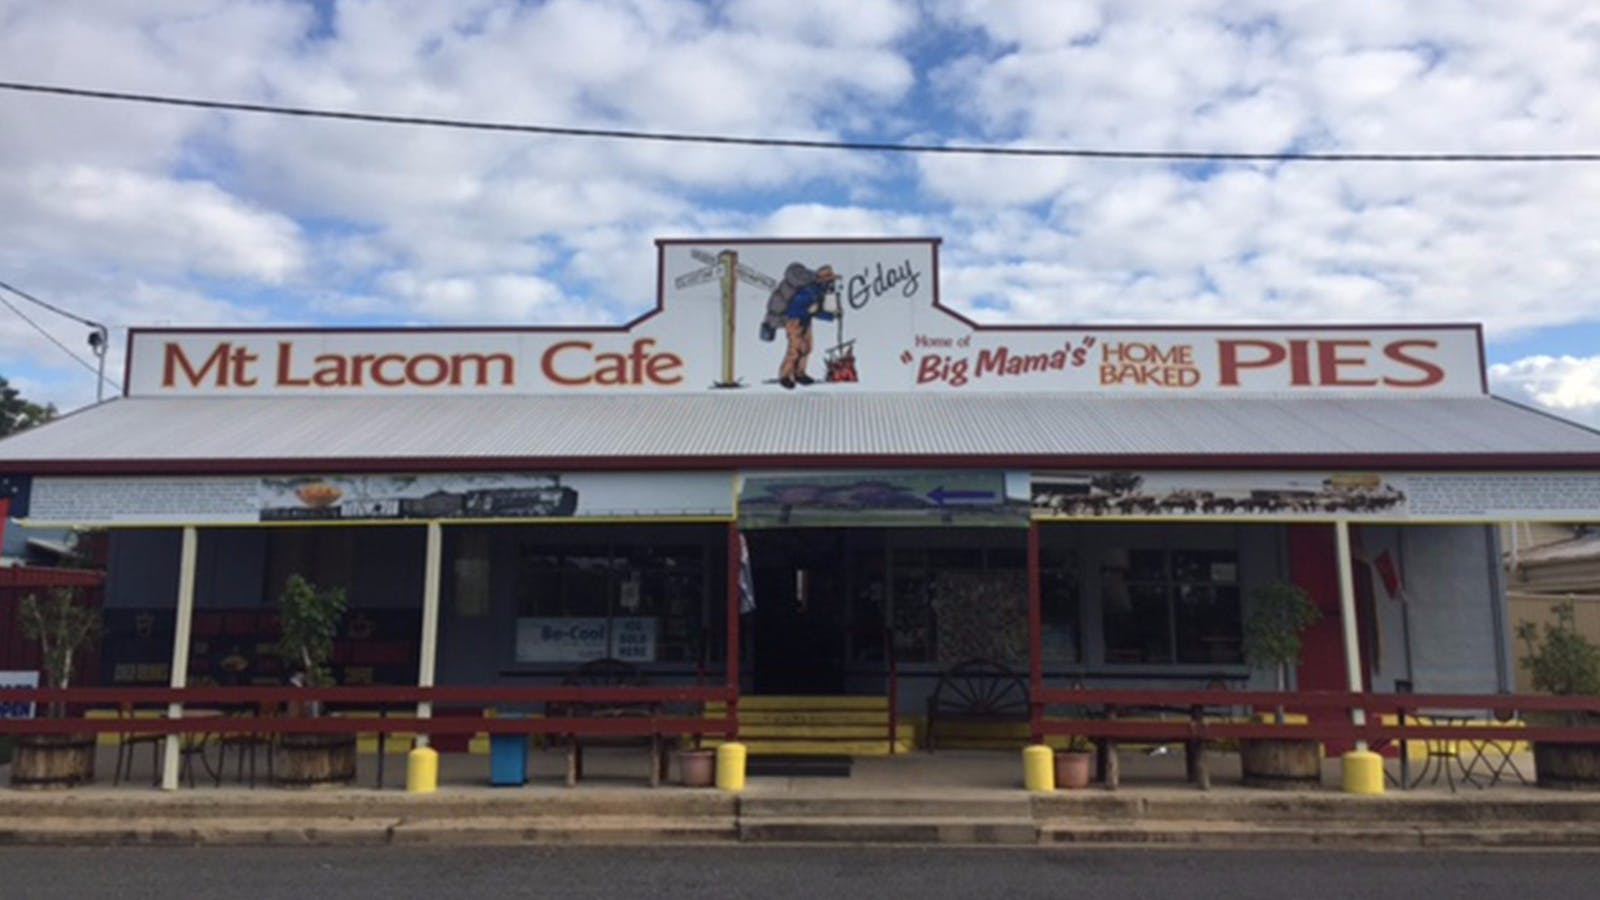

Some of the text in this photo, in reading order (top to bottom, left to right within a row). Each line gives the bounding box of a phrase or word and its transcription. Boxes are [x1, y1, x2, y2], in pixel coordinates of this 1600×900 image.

[848, 260, 921, 309] G'day
[915, 335, 971, 348] Home of
[1102, 342, 1193, 365] HOME
[162, 339, 682, 387] Mt Larcom Cafe
[1099, 363, 1200, 387] BAKED
[1217, 338, 1445, 387] PIES
